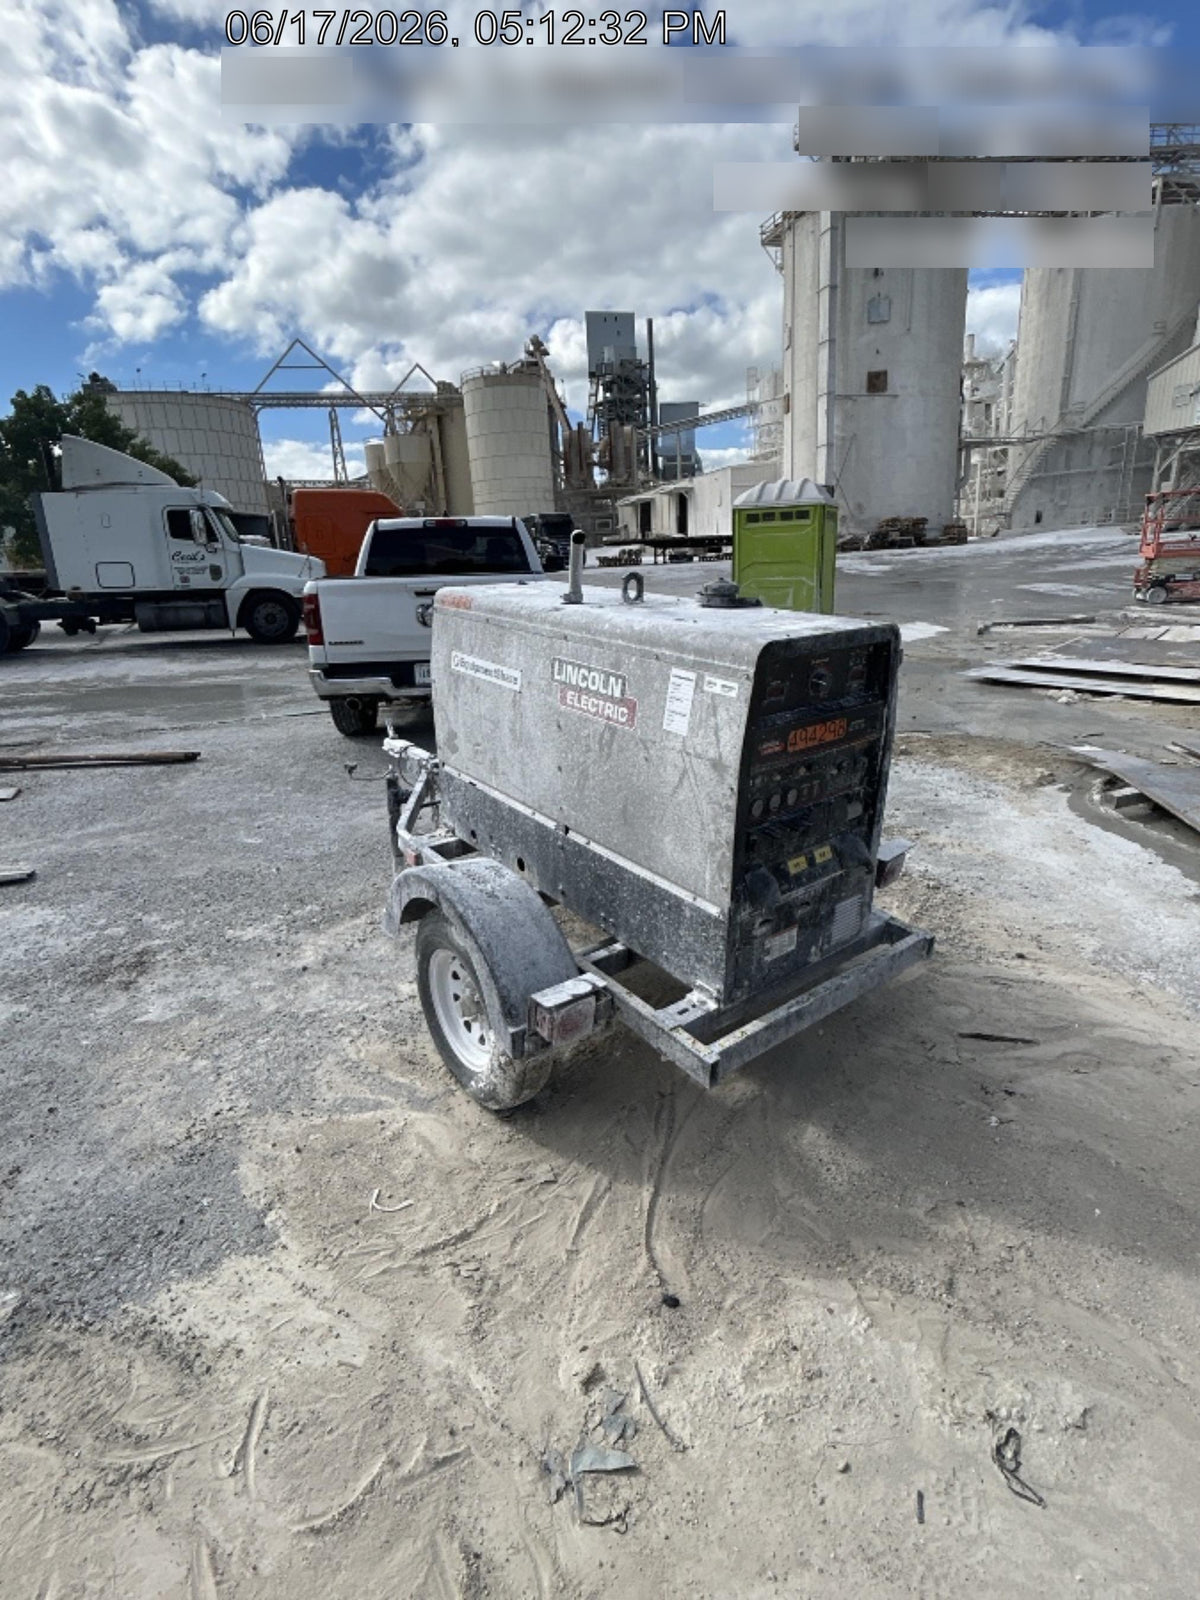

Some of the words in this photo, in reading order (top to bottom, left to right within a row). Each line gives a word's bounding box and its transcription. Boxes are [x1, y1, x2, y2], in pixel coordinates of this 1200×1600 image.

[553, 660, 623, 698] LINCOLN
[566, 690, 629, 723] ELECTRIC
[789, 719, 846, 746] 494298
